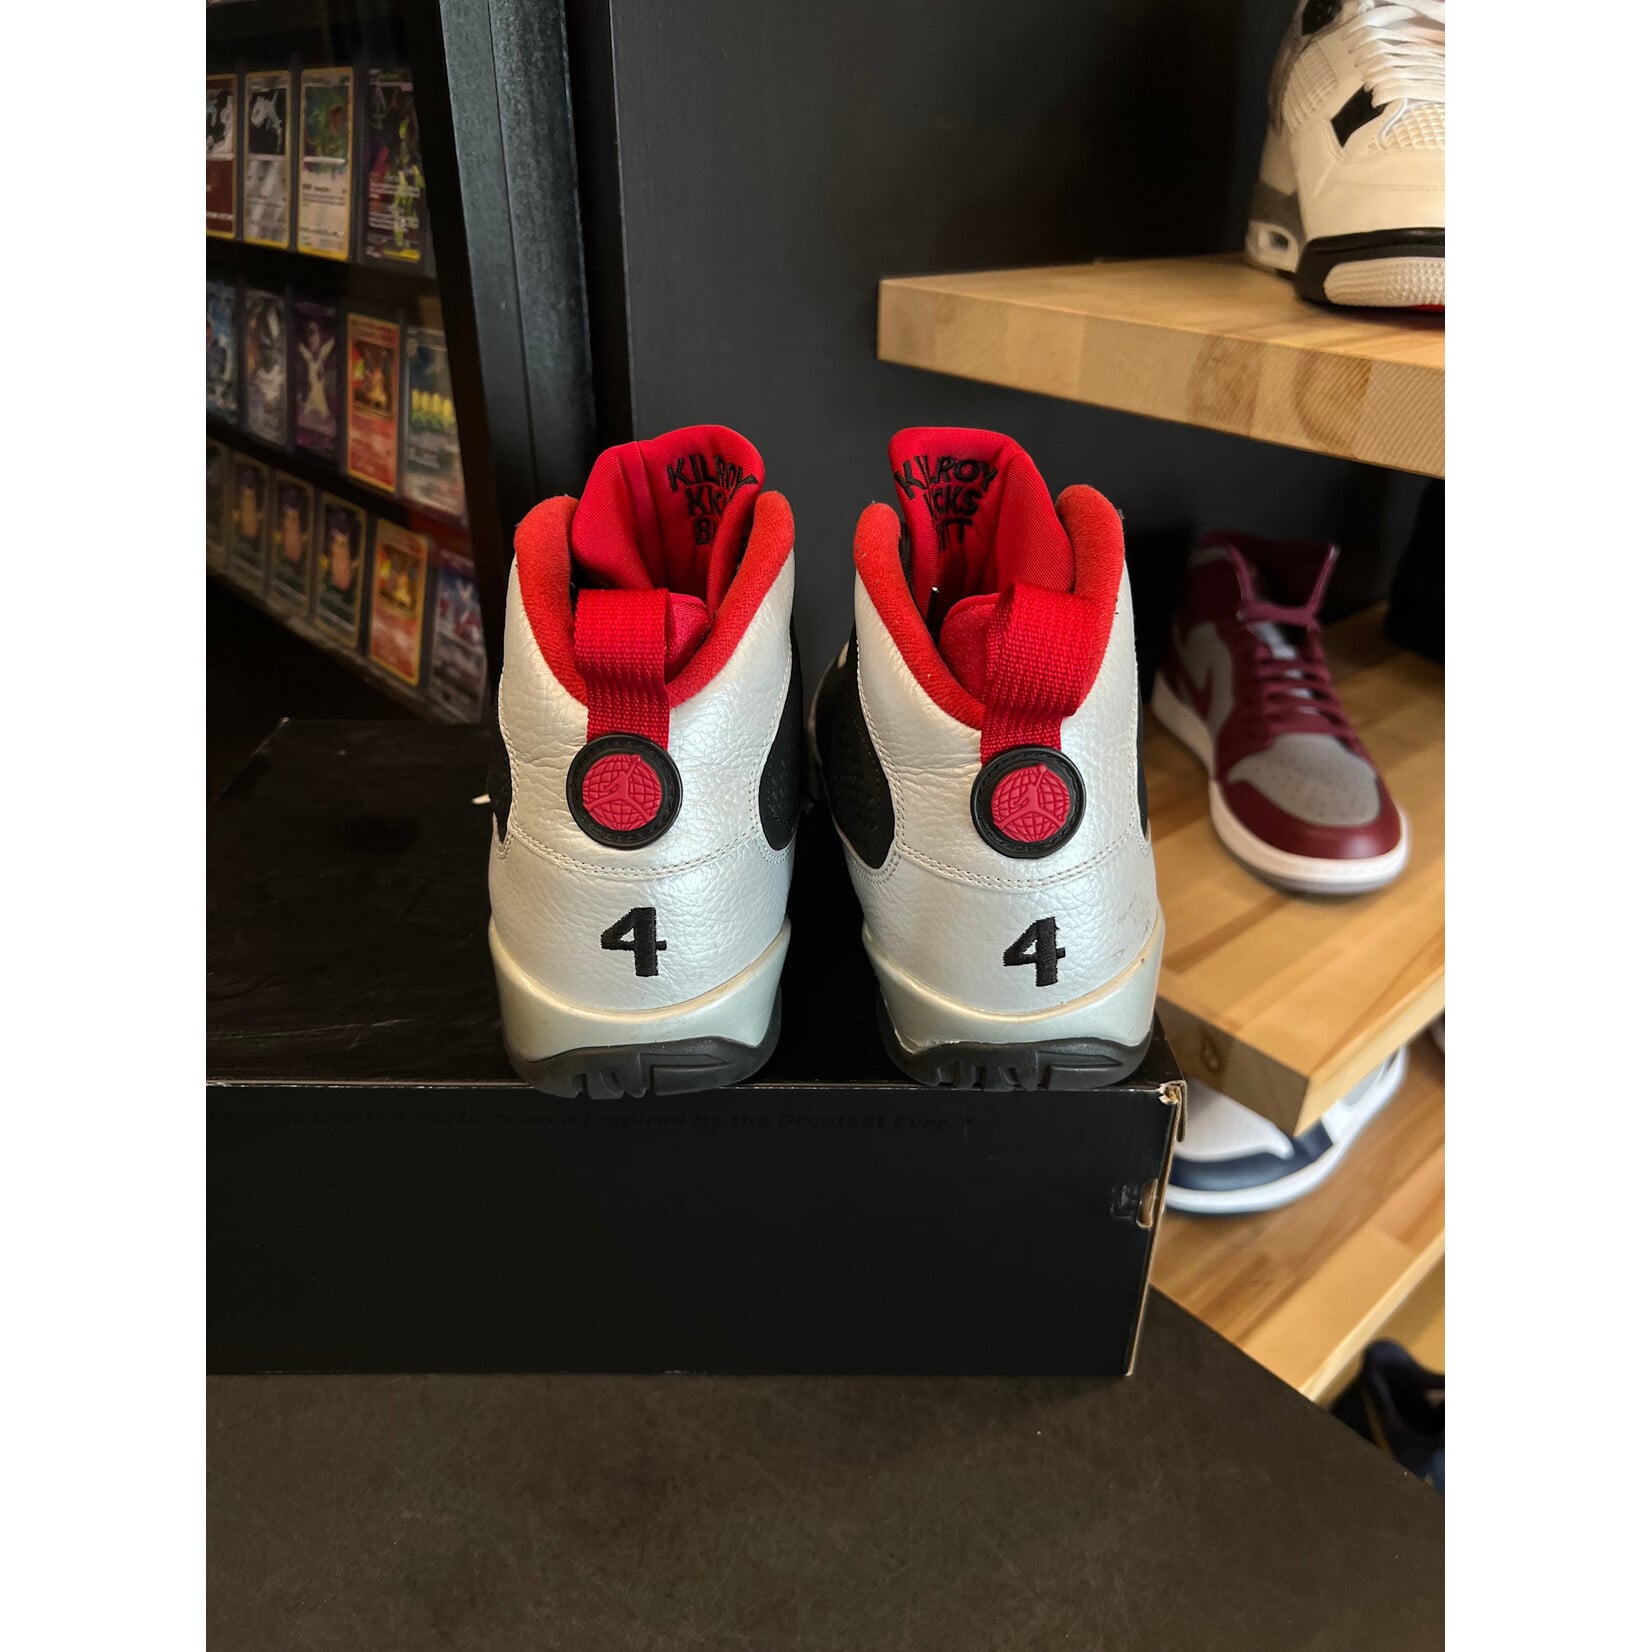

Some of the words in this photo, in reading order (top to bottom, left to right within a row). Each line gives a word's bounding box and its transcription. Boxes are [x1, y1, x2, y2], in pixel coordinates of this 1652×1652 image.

[894, 456, 998, 500] KILROY
[600, 907, 667, 977] 4
[1003, 917, 1066, 987] 4
[583, 1112, 686, 1129] Inspired
[694, 1113, 722, 1132] by
[732, 1113, 771, 1128] the
[778, 1113, 886, 1129] Greatest
